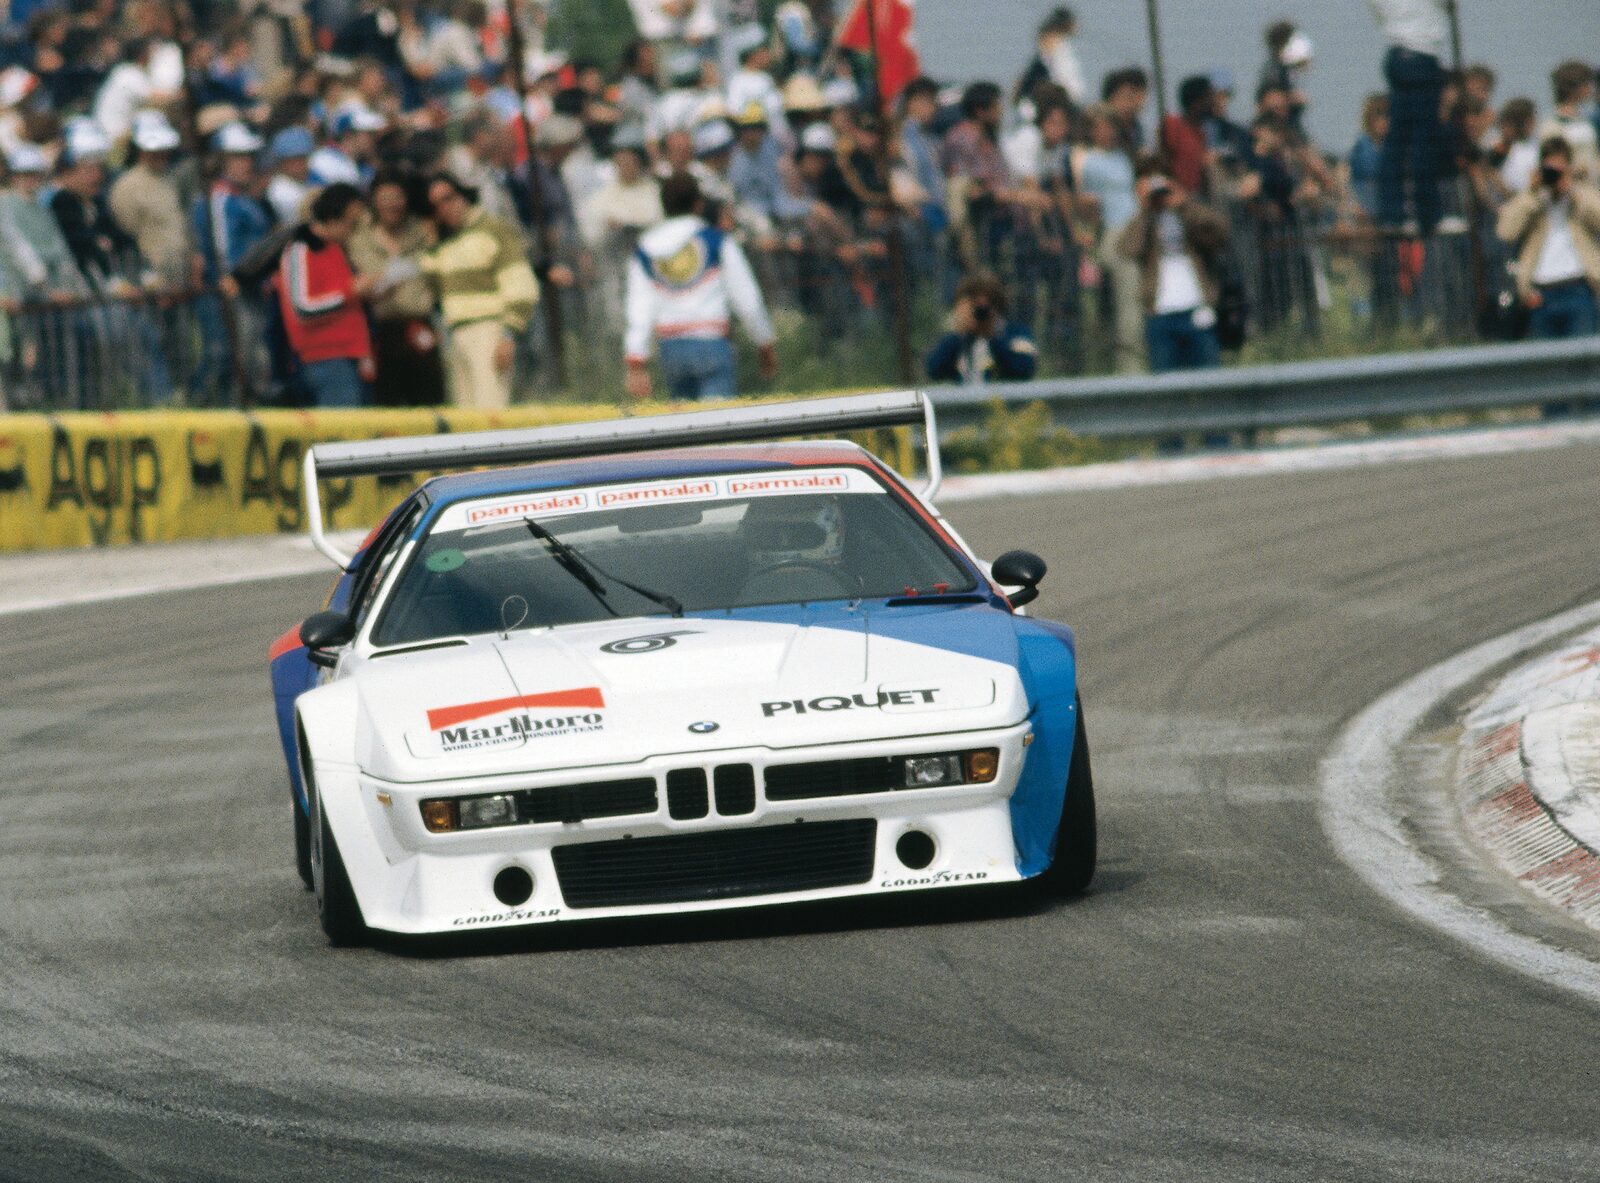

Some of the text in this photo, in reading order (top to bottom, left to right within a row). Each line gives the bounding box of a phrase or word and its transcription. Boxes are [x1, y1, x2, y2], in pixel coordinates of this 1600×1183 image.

[47, 424, 161, 545] Agip
[242, 422, 354, 532] Agp
[731, 474, 842, 494] parmalat
[601, 482, 713, 505] parmalat
[471, 495, 582, 522] parmalat
[600, 630, 704, 654] 6
[761, 688, 940, 717] PIQUET
[440, 713, 603, 745] Marlboro
[443, 740, 483, 752] WORLD
[574, 724, 603, 734] TEAM
[881, 871, 988, 887] GOODYEAR
[453, 908, 560, 925] GOODYEAR
